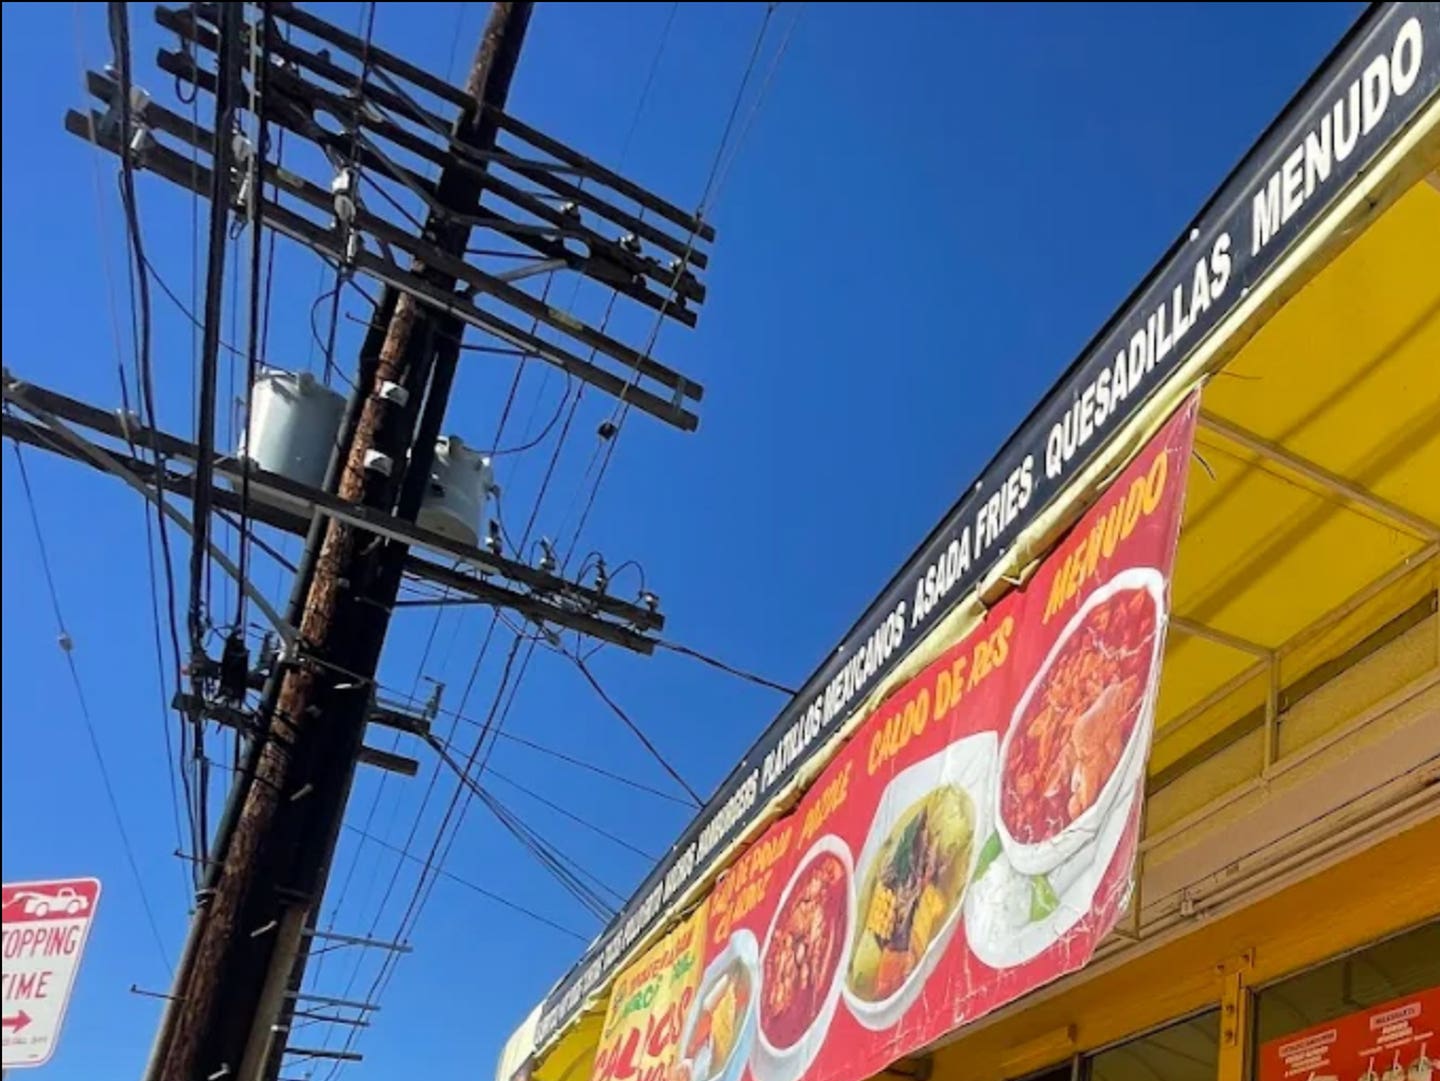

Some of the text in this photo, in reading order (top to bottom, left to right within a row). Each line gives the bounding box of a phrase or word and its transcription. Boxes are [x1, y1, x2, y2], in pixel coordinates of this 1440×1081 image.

[821, 601, 906, 727] MEXICANOS
[910, 526, 972, 628] ASADA
[973, 454, 1034, 560] FRIES
[1045, 232, 1232, 479] QUESADILLAS
[1251, 17, 1422, 257] MENUDO
[1042, 451, 1169, 625] MENUDO
[867, 615, 1015, 776] CALDO DE RES
